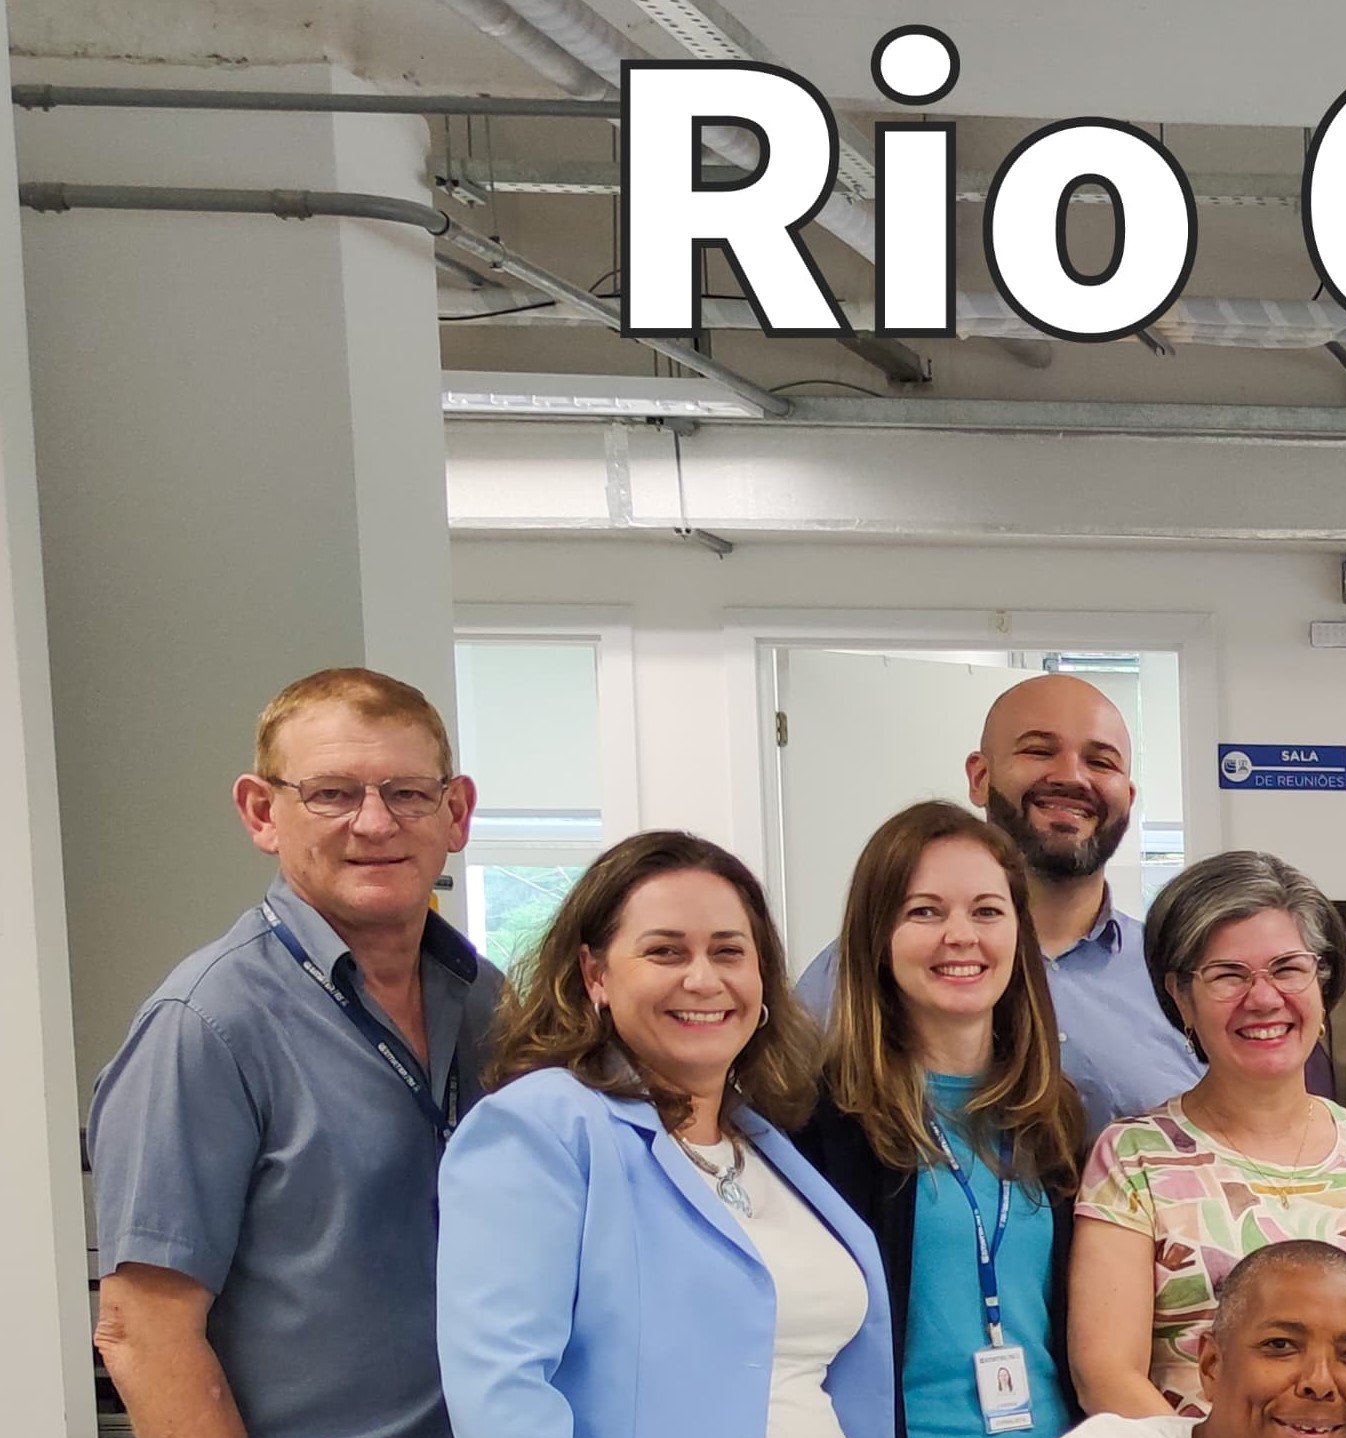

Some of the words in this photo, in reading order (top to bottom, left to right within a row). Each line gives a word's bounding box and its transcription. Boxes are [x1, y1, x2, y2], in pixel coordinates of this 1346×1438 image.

[1281, 750, 1319, 762] SALA
[1255, 775, 1273, 787] DE
[1277, 773, 1345, 788] REUNIÕES
